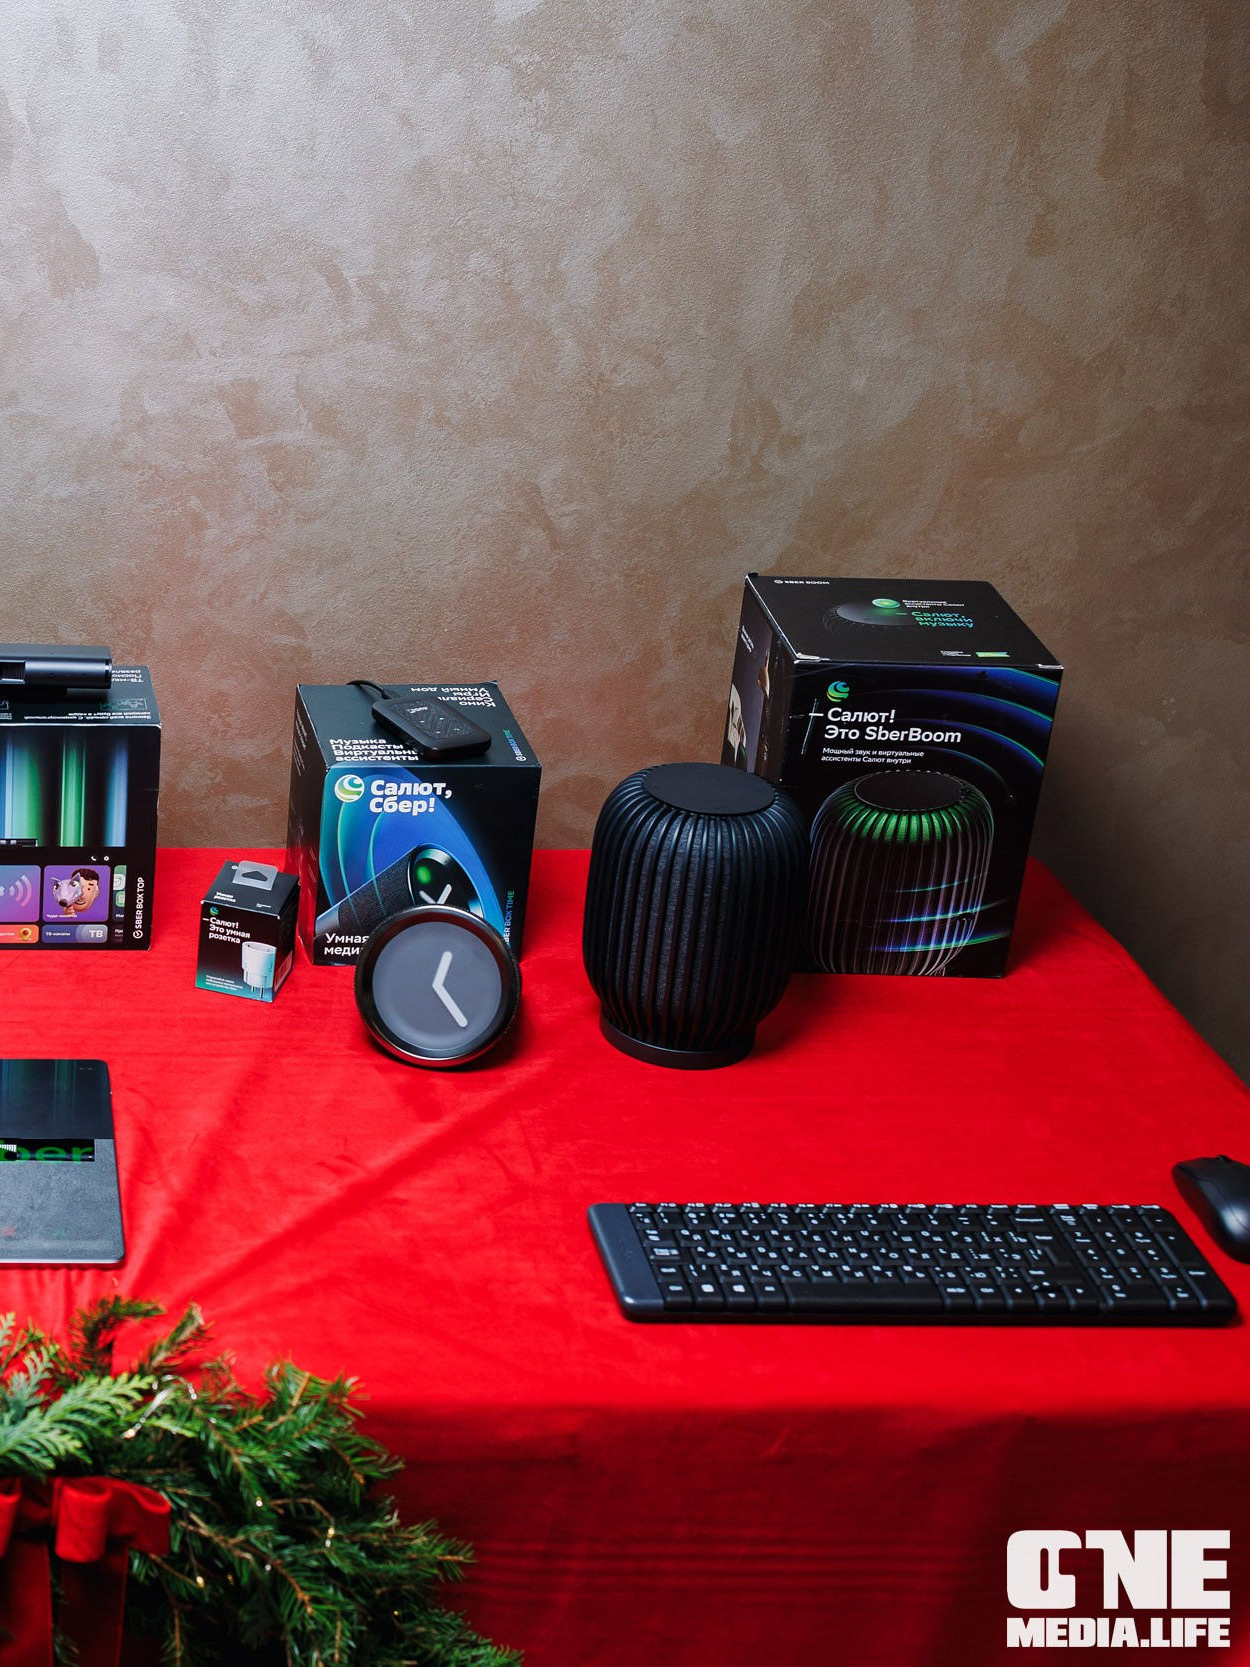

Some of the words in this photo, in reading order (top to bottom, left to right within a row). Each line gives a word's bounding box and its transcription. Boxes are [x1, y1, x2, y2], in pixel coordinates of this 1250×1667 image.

[827, 707, 897, 723] Салют!
[824, 724, 860, 740] Это
[864, 726, 962, 743] SberBoom
[330, 738, 387, 746] Музыка
[822, 747, 854, 755] Мощный
[370, 779, 453, 799] Салют,
[369, 797, 436, 816] Сбер!
[137, 876, 145, 893] TOP
[136, 893, 144, 909] BOX
[506, 890, 515, 910] TIME
[135, 910, 143, 929] SBER
[209, 916, 239, 929] Салют!
[89, 930, 103, 938] ТВ
[208, 931, 241, 944] розетка
[209, 924, 225, 933] Это
[226, 928, 251, 939] умная
[325, 933, 370, 944] Умная
[324, 946, 364, 956] меди
